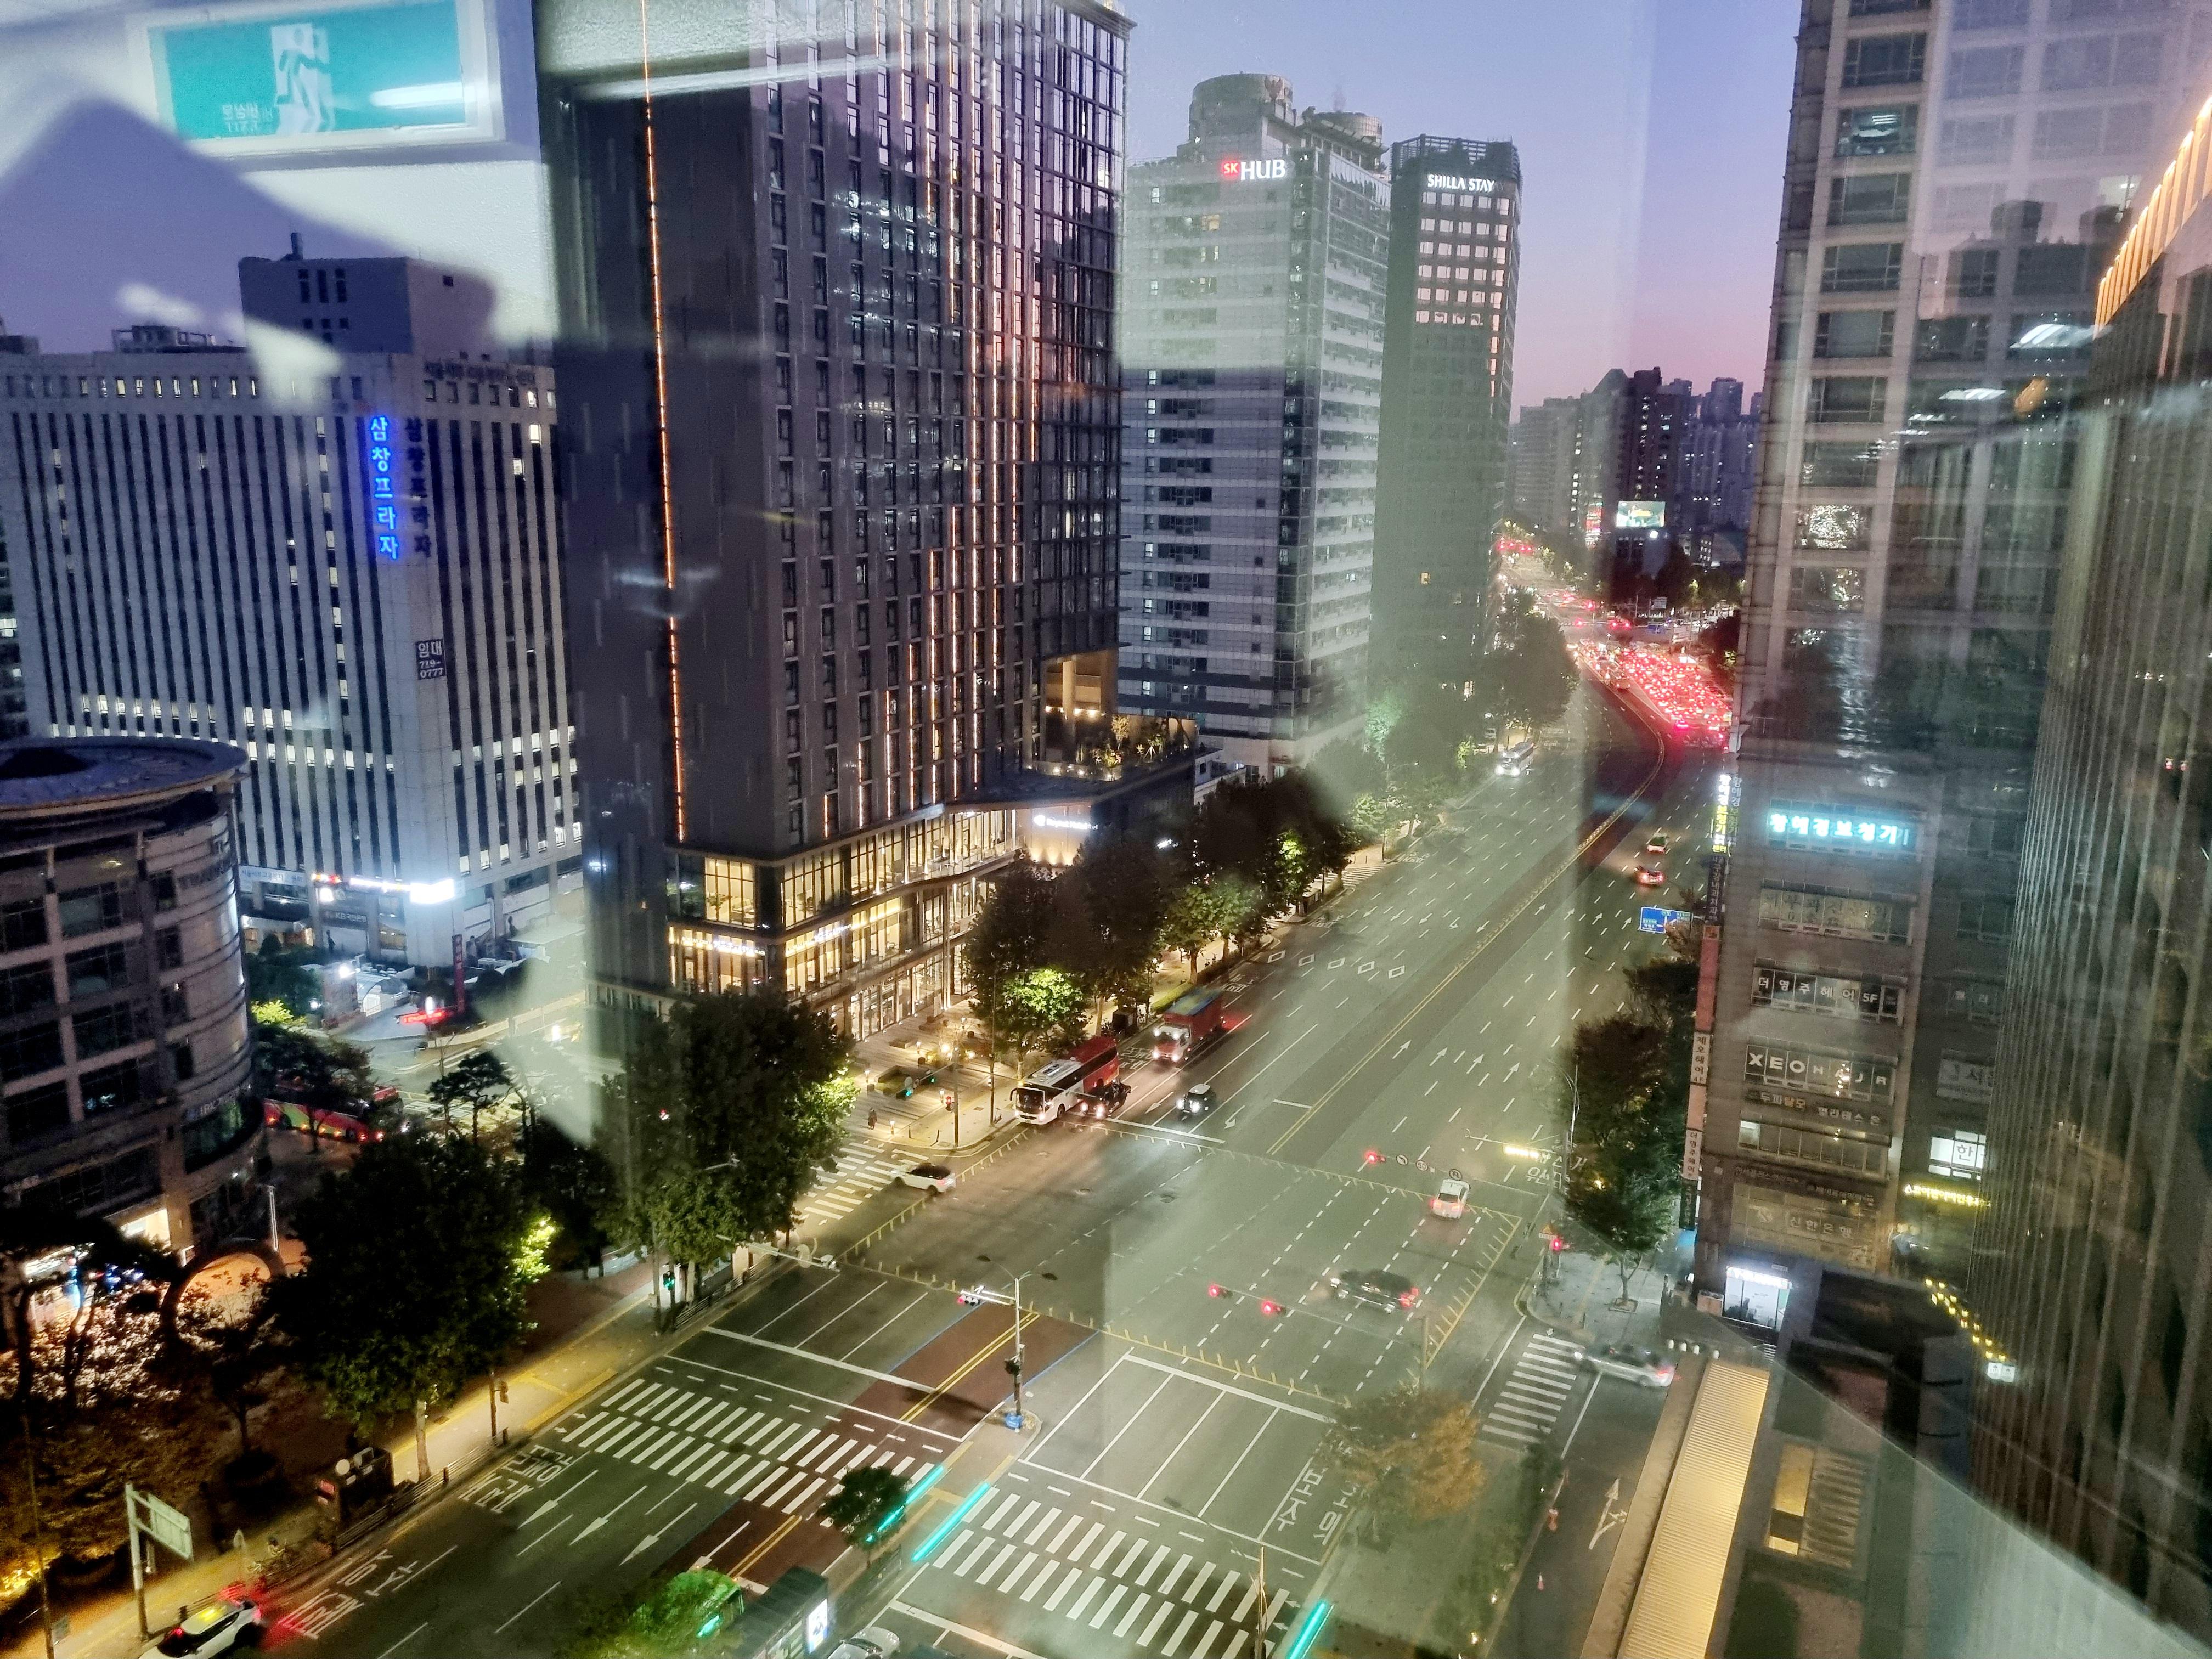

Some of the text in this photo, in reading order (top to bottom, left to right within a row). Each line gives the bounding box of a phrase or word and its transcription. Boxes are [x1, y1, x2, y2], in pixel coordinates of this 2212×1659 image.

[1223, 160, 1286, 180] SK HUB
[1427, 174, 1495, 193] SHILLA STAY
[370, 417, 398, 560] 삼창프라자
[419, 641, 442, 658] 임대
[419, 659, 442, 669] 719-
[420, 668, 443, 678] 0777
[1758, 977, 1855, 1002] 더영주헤어
[1748, 1052, 1806, 1074] XEO
[1790, 1216, 1853, 1240] 신한은행
